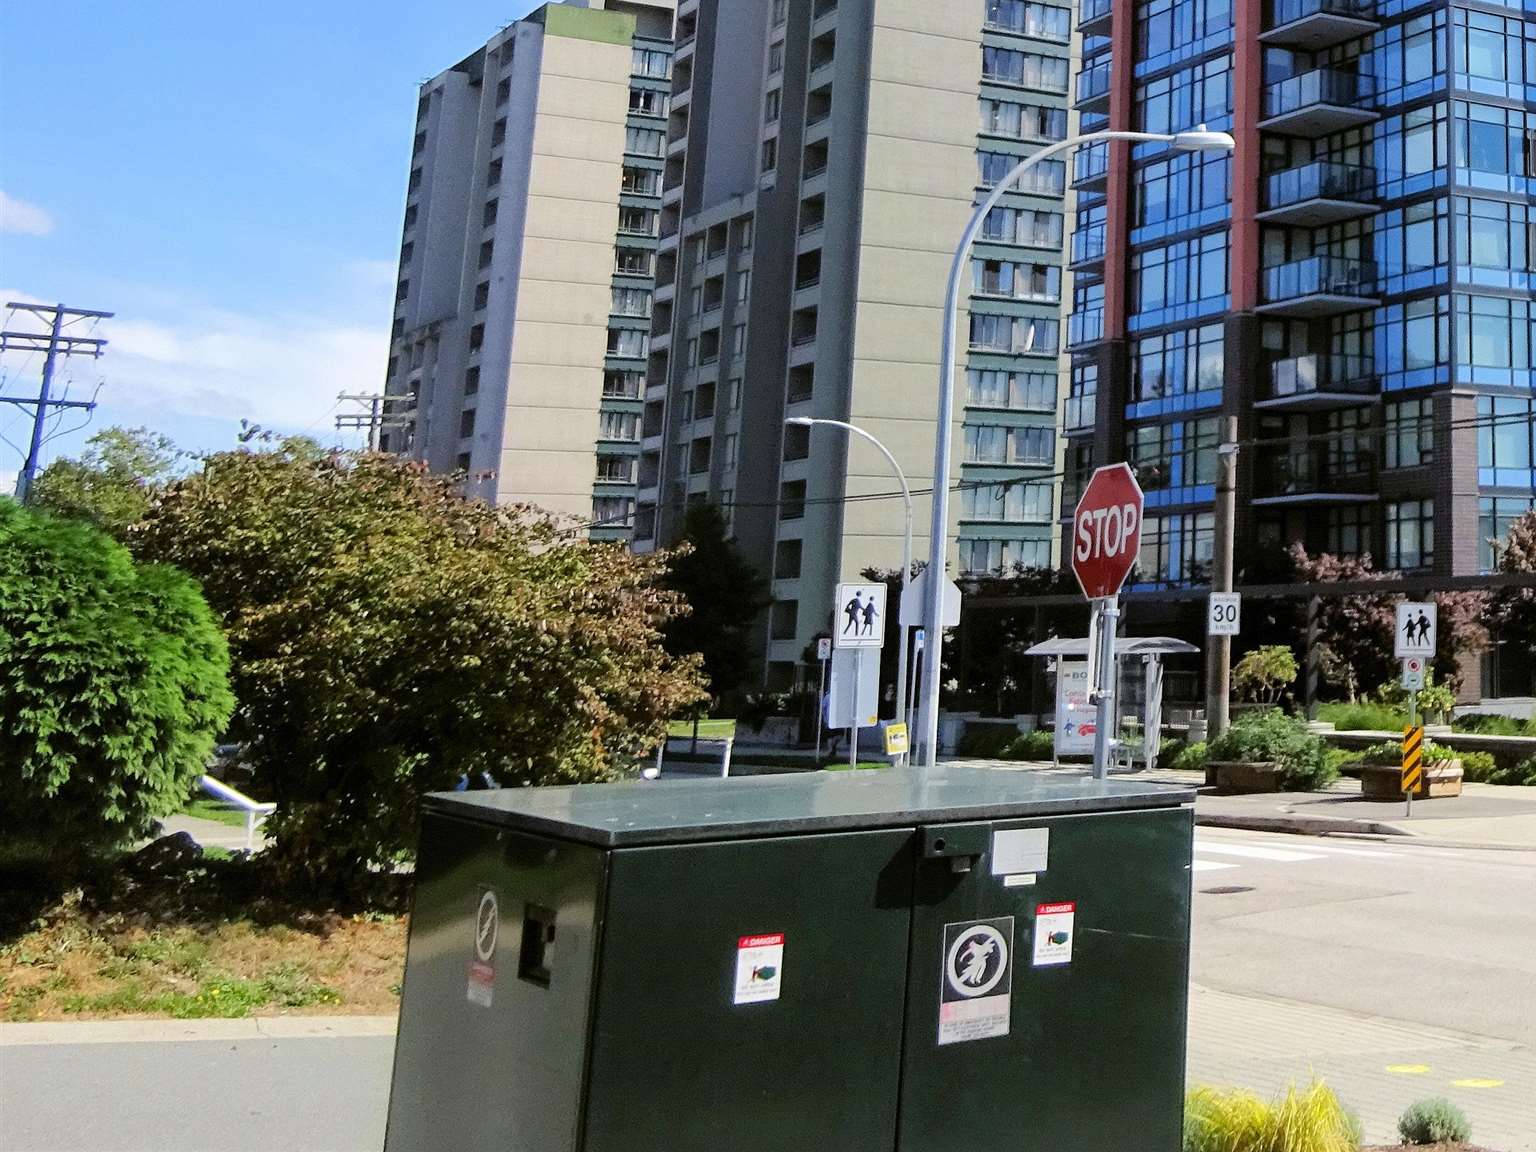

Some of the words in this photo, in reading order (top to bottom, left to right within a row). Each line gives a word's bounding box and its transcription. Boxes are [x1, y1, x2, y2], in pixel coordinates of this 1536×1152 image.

[1077, 504, 1136, 562] STOP
[1213, 604, 1236, 622] 30
[1046, 904, 1072, 913] DANGER
